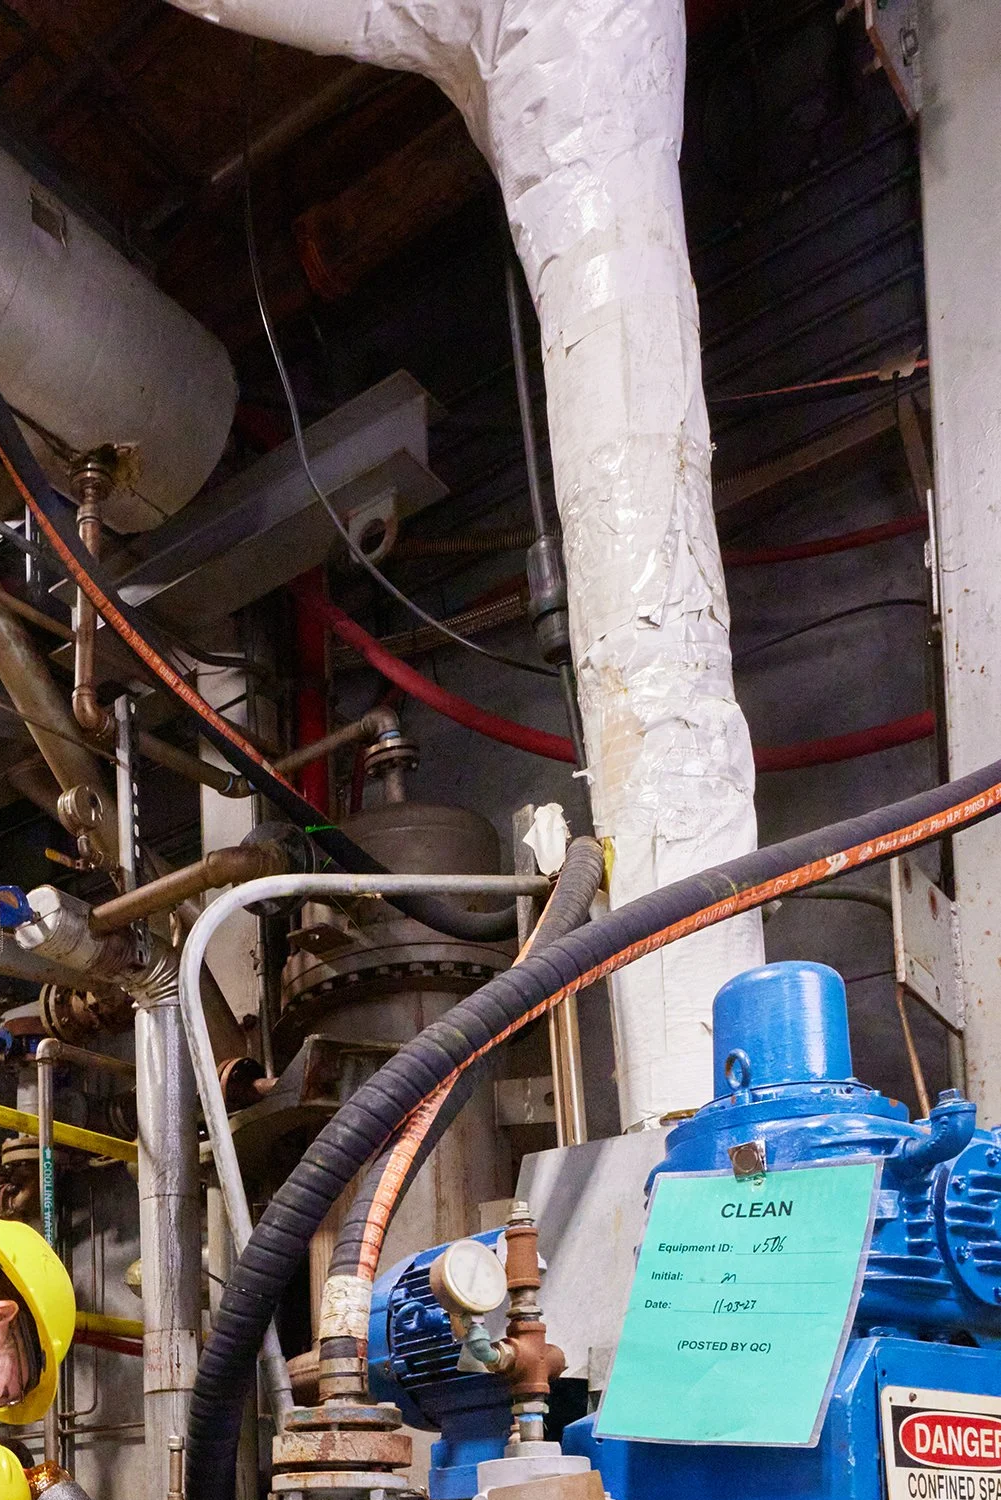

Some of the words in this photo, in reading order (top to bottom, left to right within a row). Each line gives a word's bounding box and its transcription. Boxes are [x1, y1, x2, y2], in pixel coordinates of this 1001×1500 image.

[694, 900, 735, 927] CAUTION
[44, 1162, 53, 1209] COOLING
[720, 1200, 793, 1218] CLEAN
[658, 1243, 716, 1253] Equipment
[717, 1243, 734, 1253] ID:
[651, 1271, 684, 1281] Initial:
[644, 1300, 672, 1309] Date:
[677, 1340, 728, 1351] (POSTED
[730, 1342, 748, 1351] BY
[749, 1342, 772, 1353] QC)
[908, 1473, 976, 1500] CONFINED
